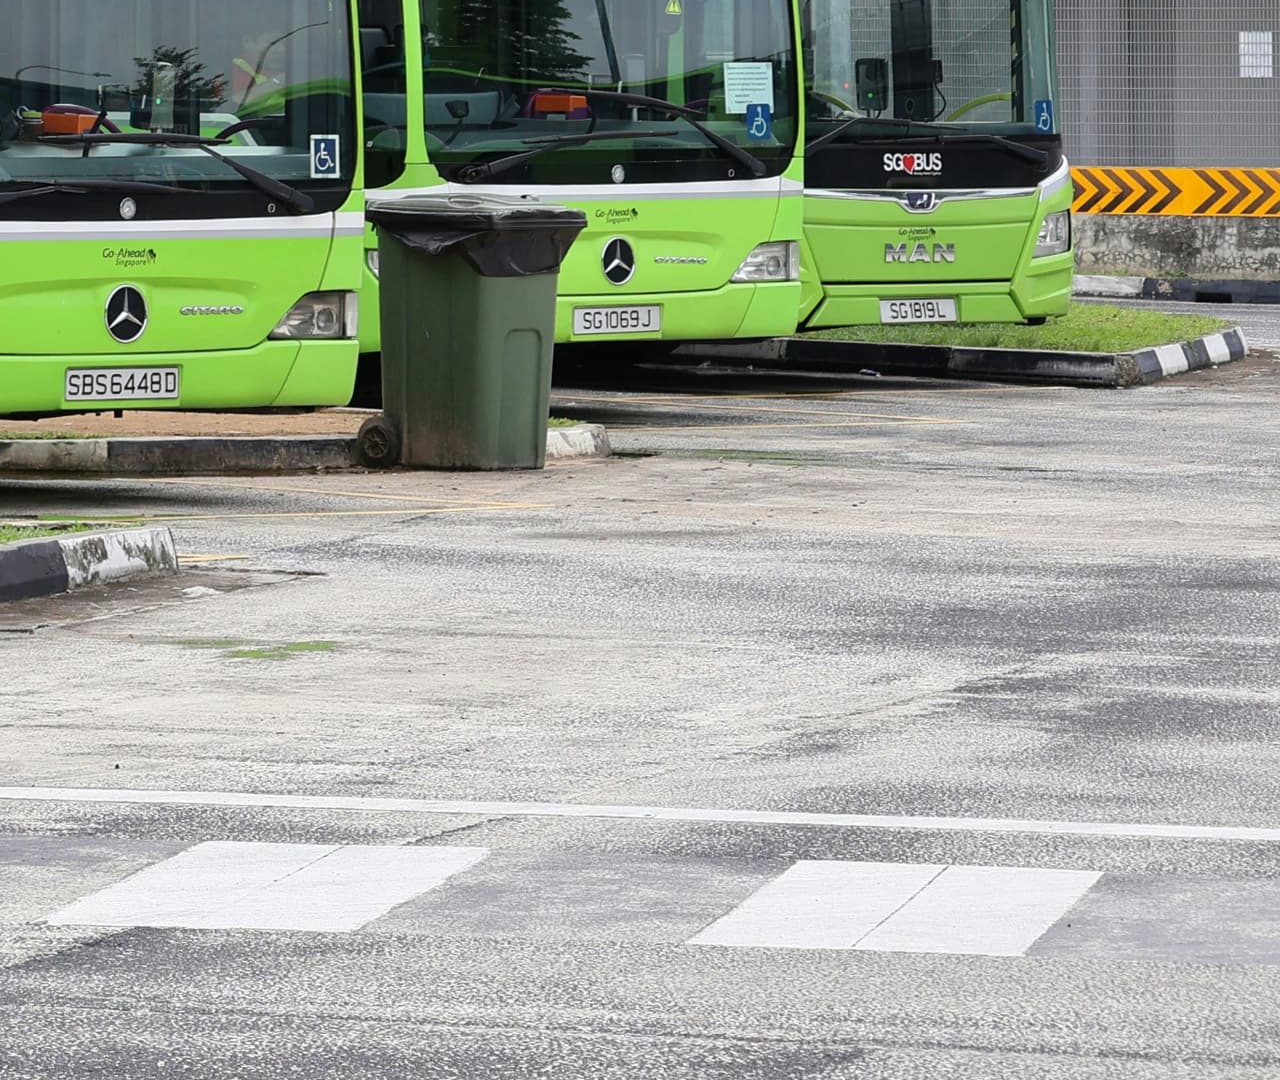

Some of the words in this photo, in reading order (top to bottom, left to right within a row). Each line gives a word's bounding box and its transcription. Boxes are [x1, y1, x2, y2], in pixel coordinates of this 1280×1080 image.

[102, 248, 146, 258] Go-Ahead
[884, 243, 955, 263] MAN
[583, 309, 652, 330] SG1069J
[890, 302, 946, 319] SG1819L
[68, 372, 176, 395] SBS6448D
